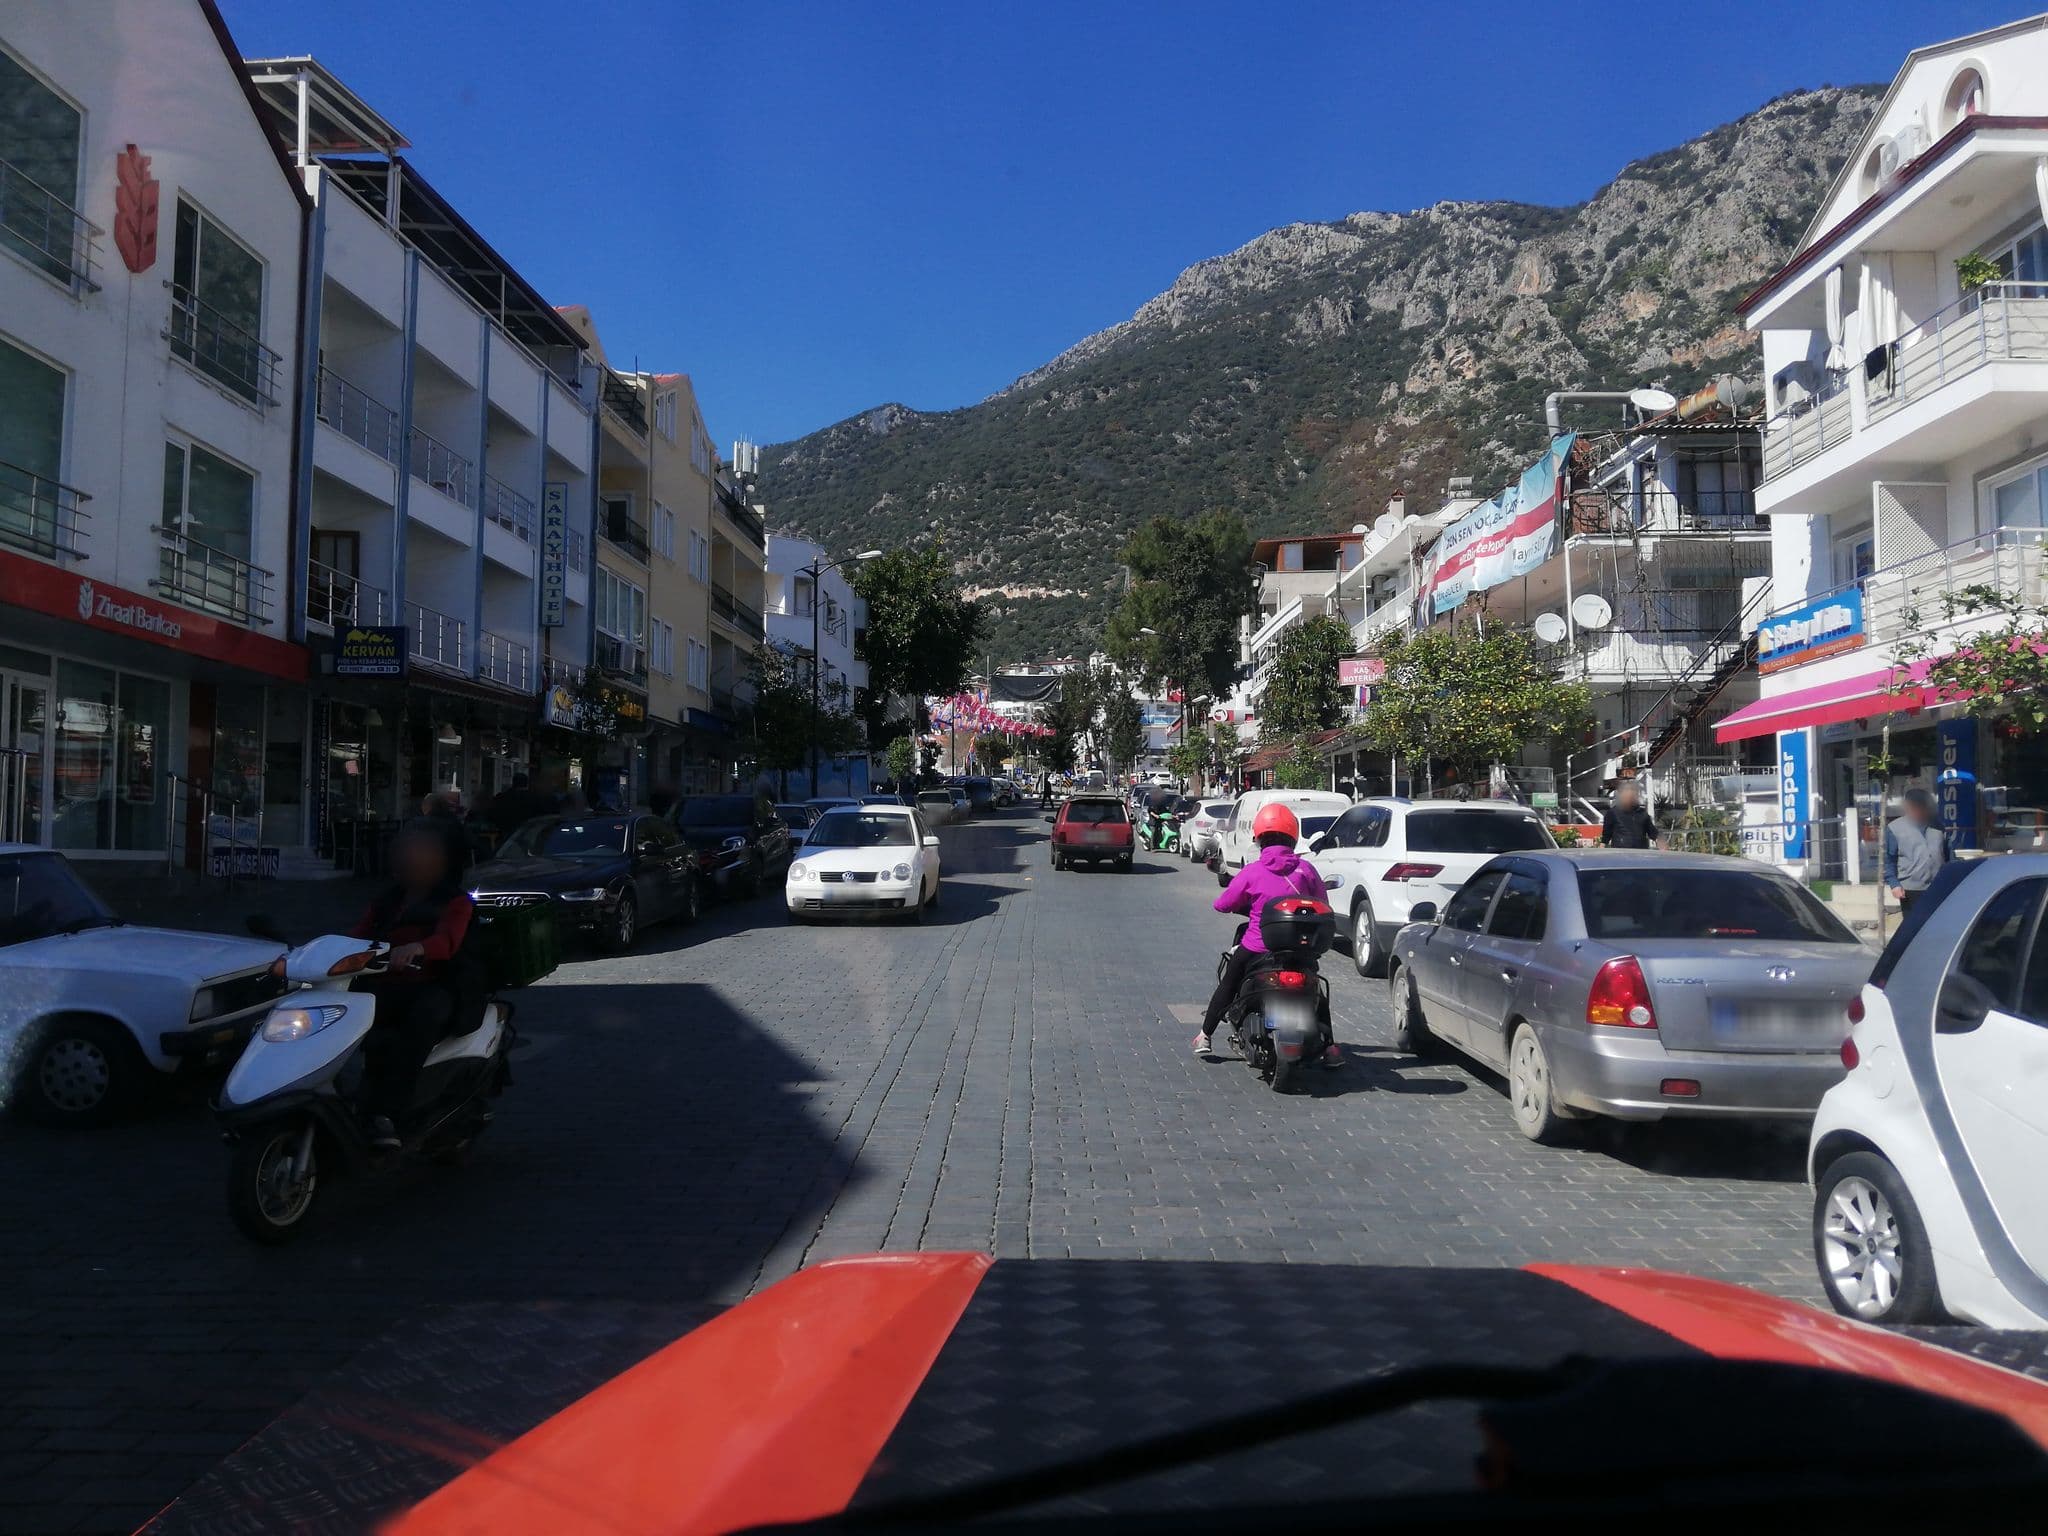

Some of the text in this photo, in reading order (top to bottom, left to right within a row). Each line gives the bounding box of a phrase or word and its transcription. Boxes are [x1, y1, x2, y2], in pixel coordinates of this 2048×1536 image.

[546, 490, 563, 553] SARAY
[95, 594, 136, 625] Ziraat
[545, 562, 562, 624] HOTEL
[342, 645, 396, 657] KERVAN
[1783, 751, 1799, 841] casper
